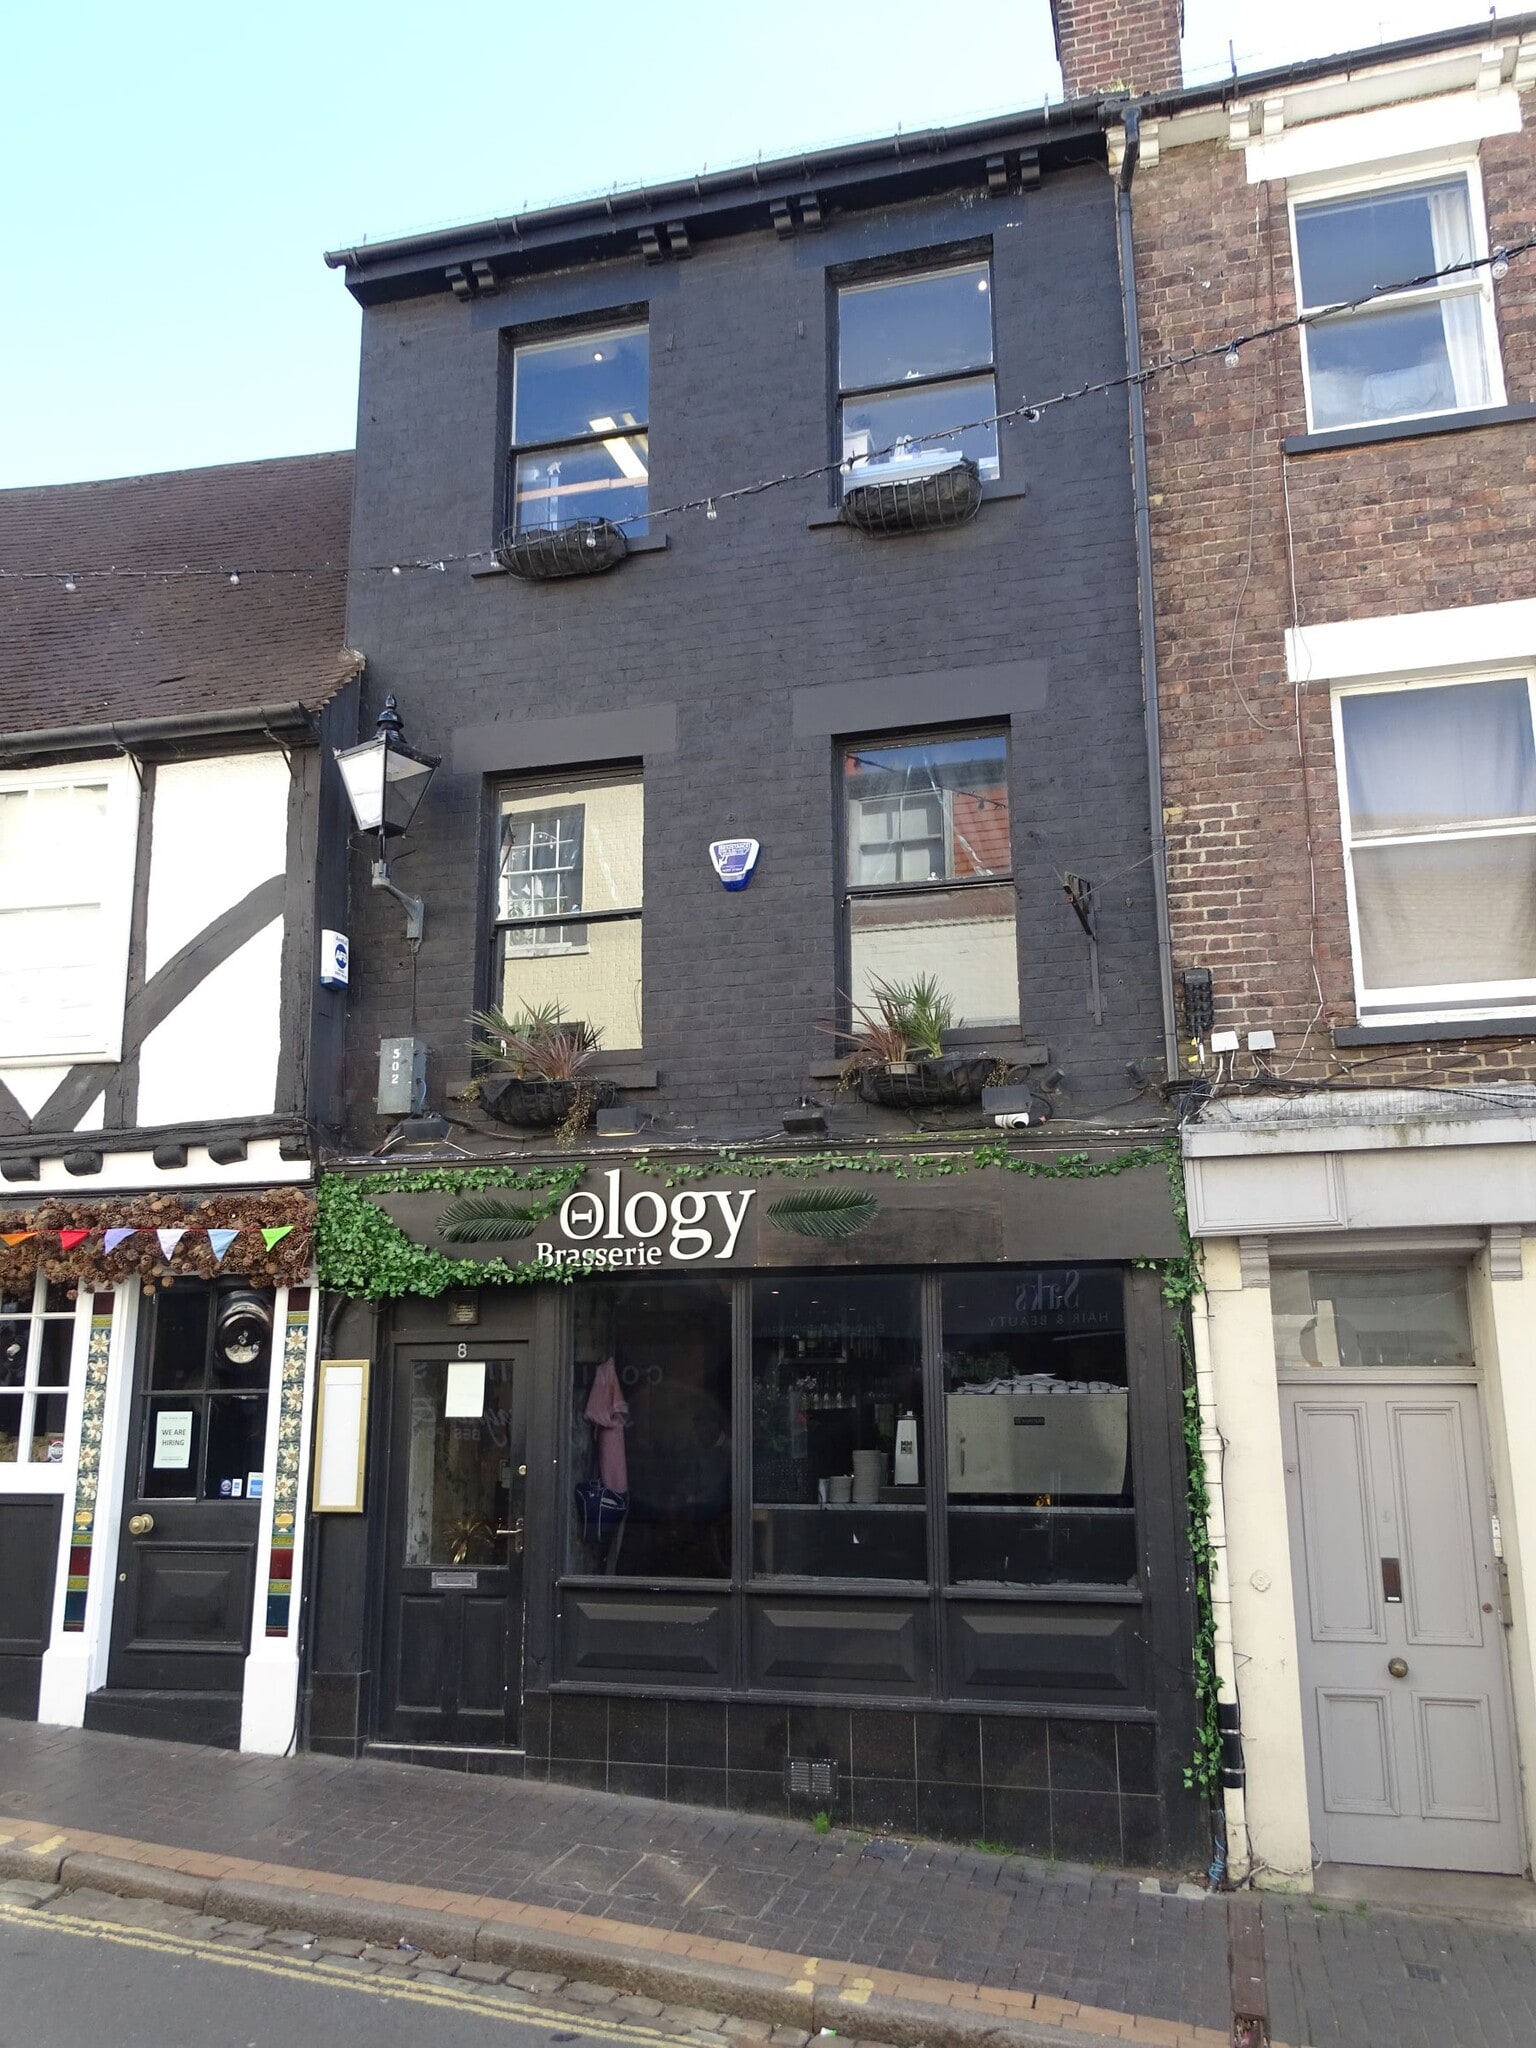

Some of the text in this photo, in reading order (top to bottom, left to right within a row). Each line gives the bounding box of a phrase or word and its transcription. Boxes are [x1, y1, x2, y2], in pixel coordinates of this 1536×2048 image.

[391, 1048, 400, 1084] 502
[536, 1241, 662, 1268] Brasserie
[457, 1343, 467, 1358] 8
